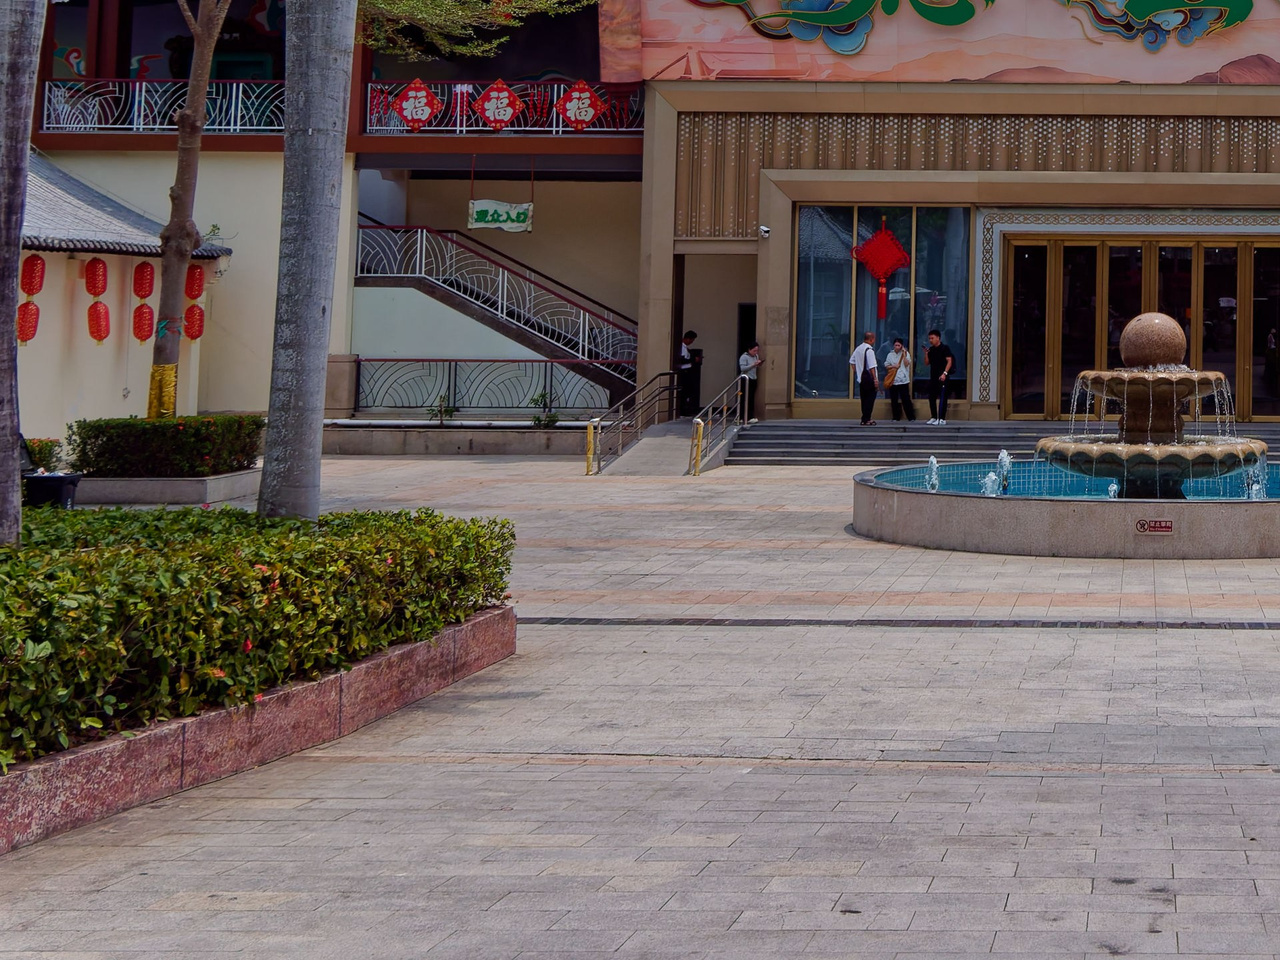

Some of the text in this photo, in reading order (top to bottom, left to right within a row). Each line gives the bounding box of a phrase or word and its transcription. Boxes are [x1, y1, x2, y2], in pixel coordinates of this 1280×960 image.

[402, 90, 431, 120] 福
[484, 91, 514, 121] 福
[565, 91, 595, 122] 福
[474, 209, 529, 224] 观众入口
